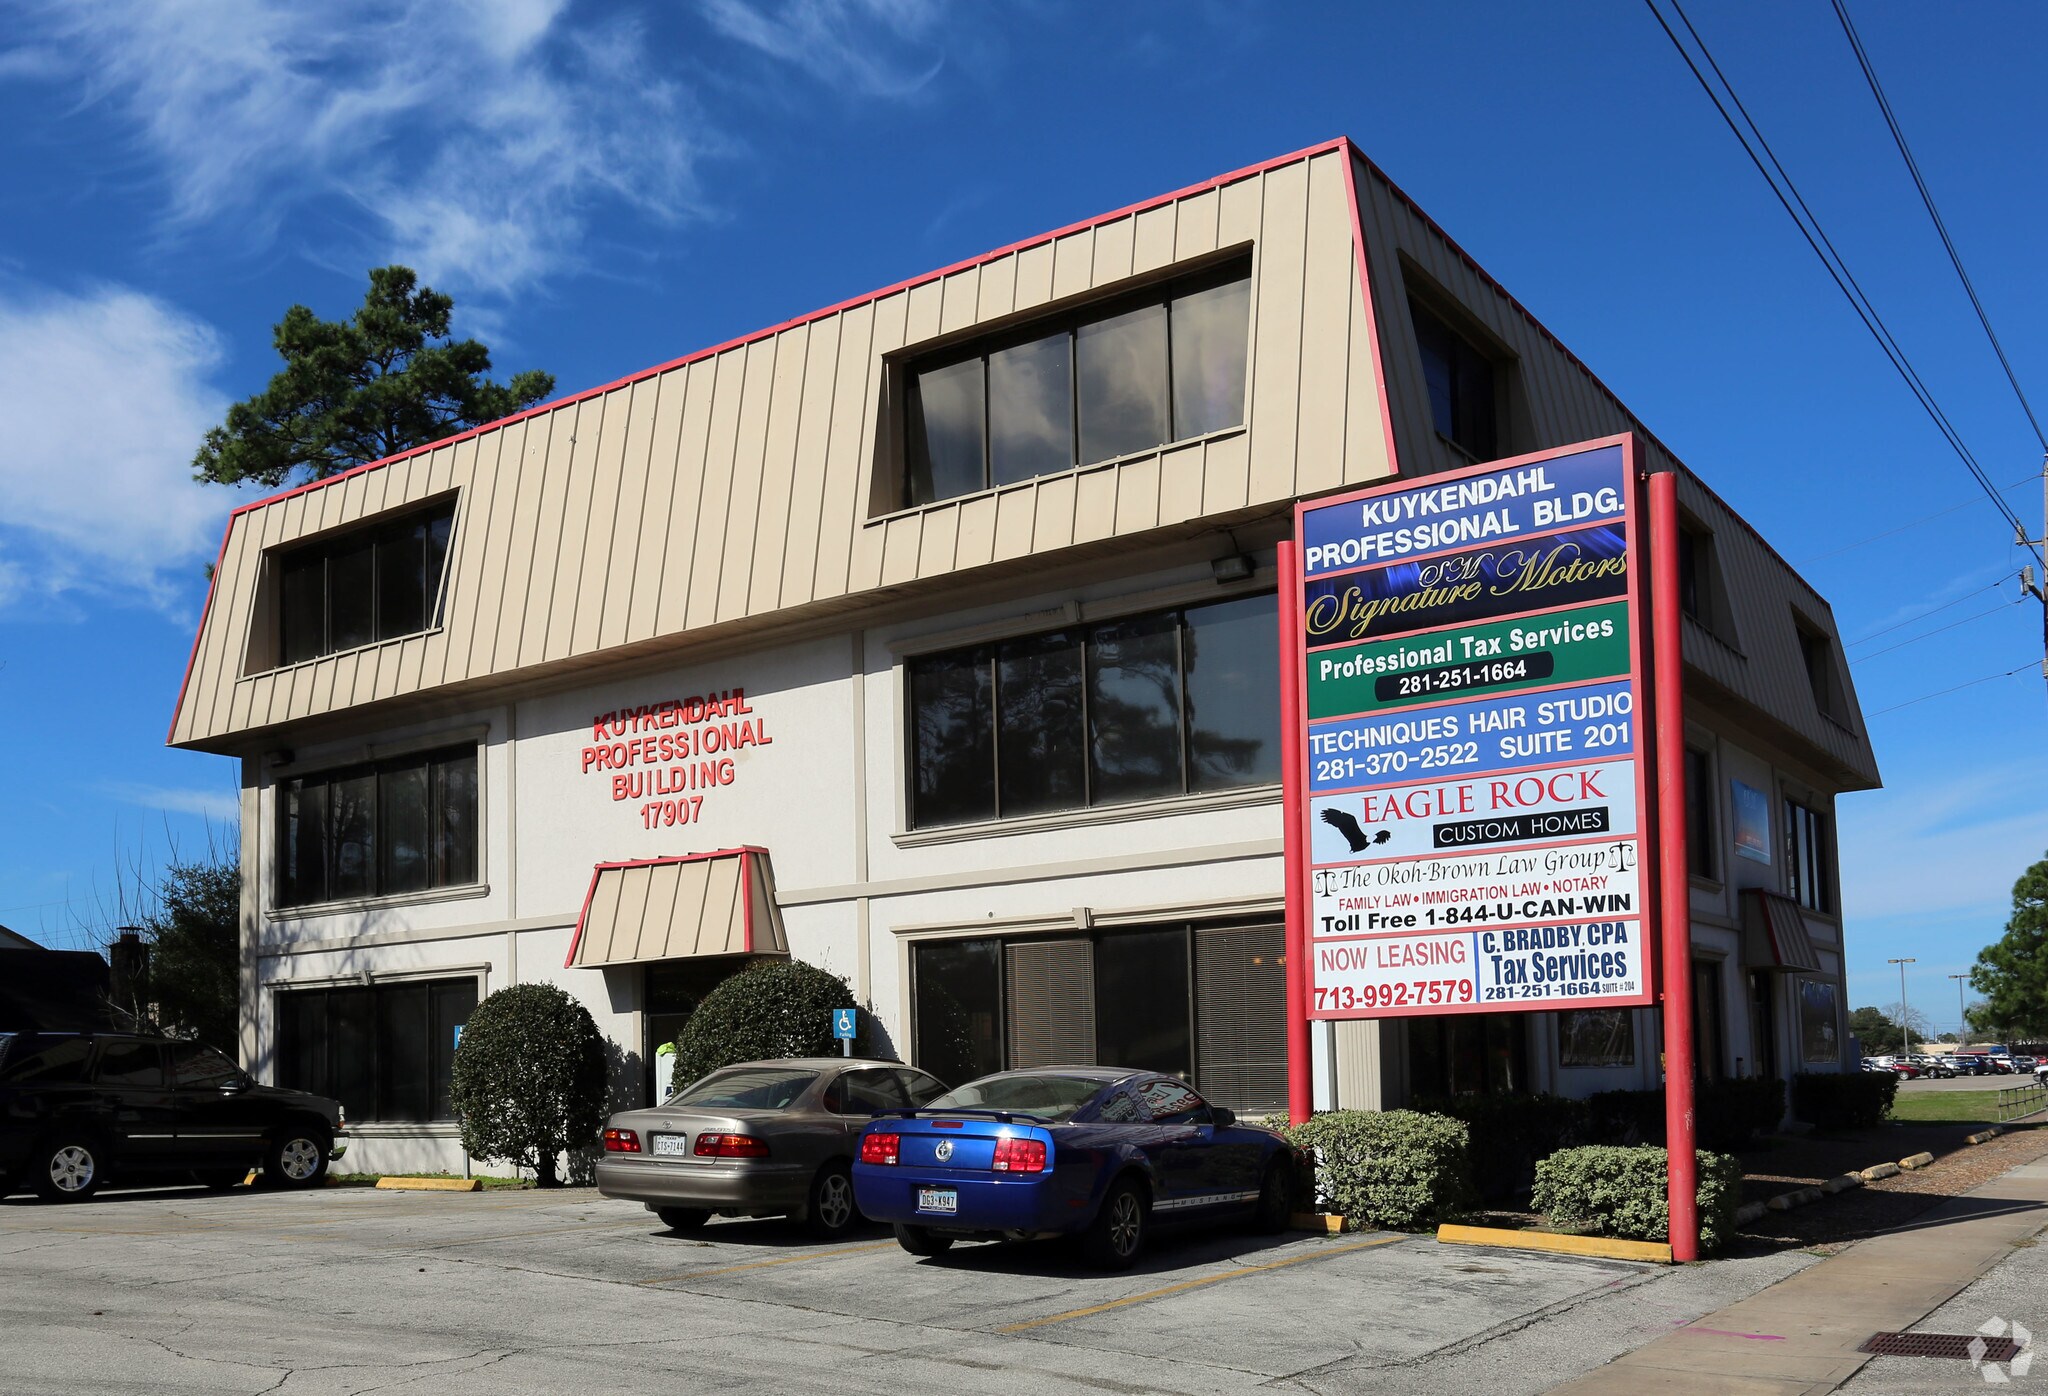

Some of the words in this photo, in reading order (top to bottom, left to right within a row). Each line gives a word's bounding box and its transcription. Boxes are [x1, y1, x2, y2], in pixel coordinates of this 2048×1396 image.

[1362, 466, 1555, 528] KUYKENDAHL
[1306, 508, 1520, 571] PROFESSIONAL
[1534, 487, 1625, 527] BLDG.
[1419, 553, 1494, 587] SM
[1306, 581, 1482, 638] Signature
[1490, 542, 1627, 596] Motors
[1320, 640, 1453, 681] Professional
[1460, 636, 1501, 659] Tax
[1510, 618, 1614, 652] Services
[1400, 660, 1526, 695] 281-251-1664
[593, 688, 753, 742] KUYKENDAHL
[1310, 716, 1459, 755] TECHNIQUES
[1470, 706, 1526, 734] HAIR
[1538, 692, 1632, 725] STUDIO
[582, 718, 772, 774] PROFESSIONAL
[1316, 742, 1478, 781] 281-370-2522
[1500, 730, 1572, 759] SUITE
[1584, 722, 1629, 748] 201
[612, 758, 735, 800] BUILDING
[1362, 784, 1474, 824] EAGLE
[1490, 770, 1608, 809] ROCK
[640, 796, 704, 829] 17907
[1438, 822, 1520, 844] CUSTOM
[1532, 812, 1602, 834] HOMES
[1340, 866, 1370, 888] The
[1378, 860, 1490, 886] Okoh-Brown
[1496, 856, 1537, 876] Law
[1545, 850, 1605, 876] Group
[1339, 896, 1382, 911] FAMILY
[1385, 893, 1412, 908] LAW
[1422, 885, 1508, 905] IMMIGRATION
[1512, 882, 1541, 897] LAW
[1553, 876, 1608, 894] NOTARY
[1321, 914, 1360, 932] Toll
[1368, 913, 1416, 929] Free
[1426, 894, 1630, 925] 1-844-U-CAN-WIN
[1322, 947, 1368, 972] NOW
[1377, 940, 1465, 968] LEASING
[1483, 932, 1500, 954] C.
[1587, 922, 1628, 946] CPA
[1491, 955, 1528, 985] Tax
[1532, 949, 1627, 983] Services
[1314, 979, 1472, 1010] 713-992-7579
[1486, 982, 1601, 1000] 281-251-1664
[1602, 982, 1618, 993] SUITE
[1181, 1194, 1236, 1206] MUSTANG
